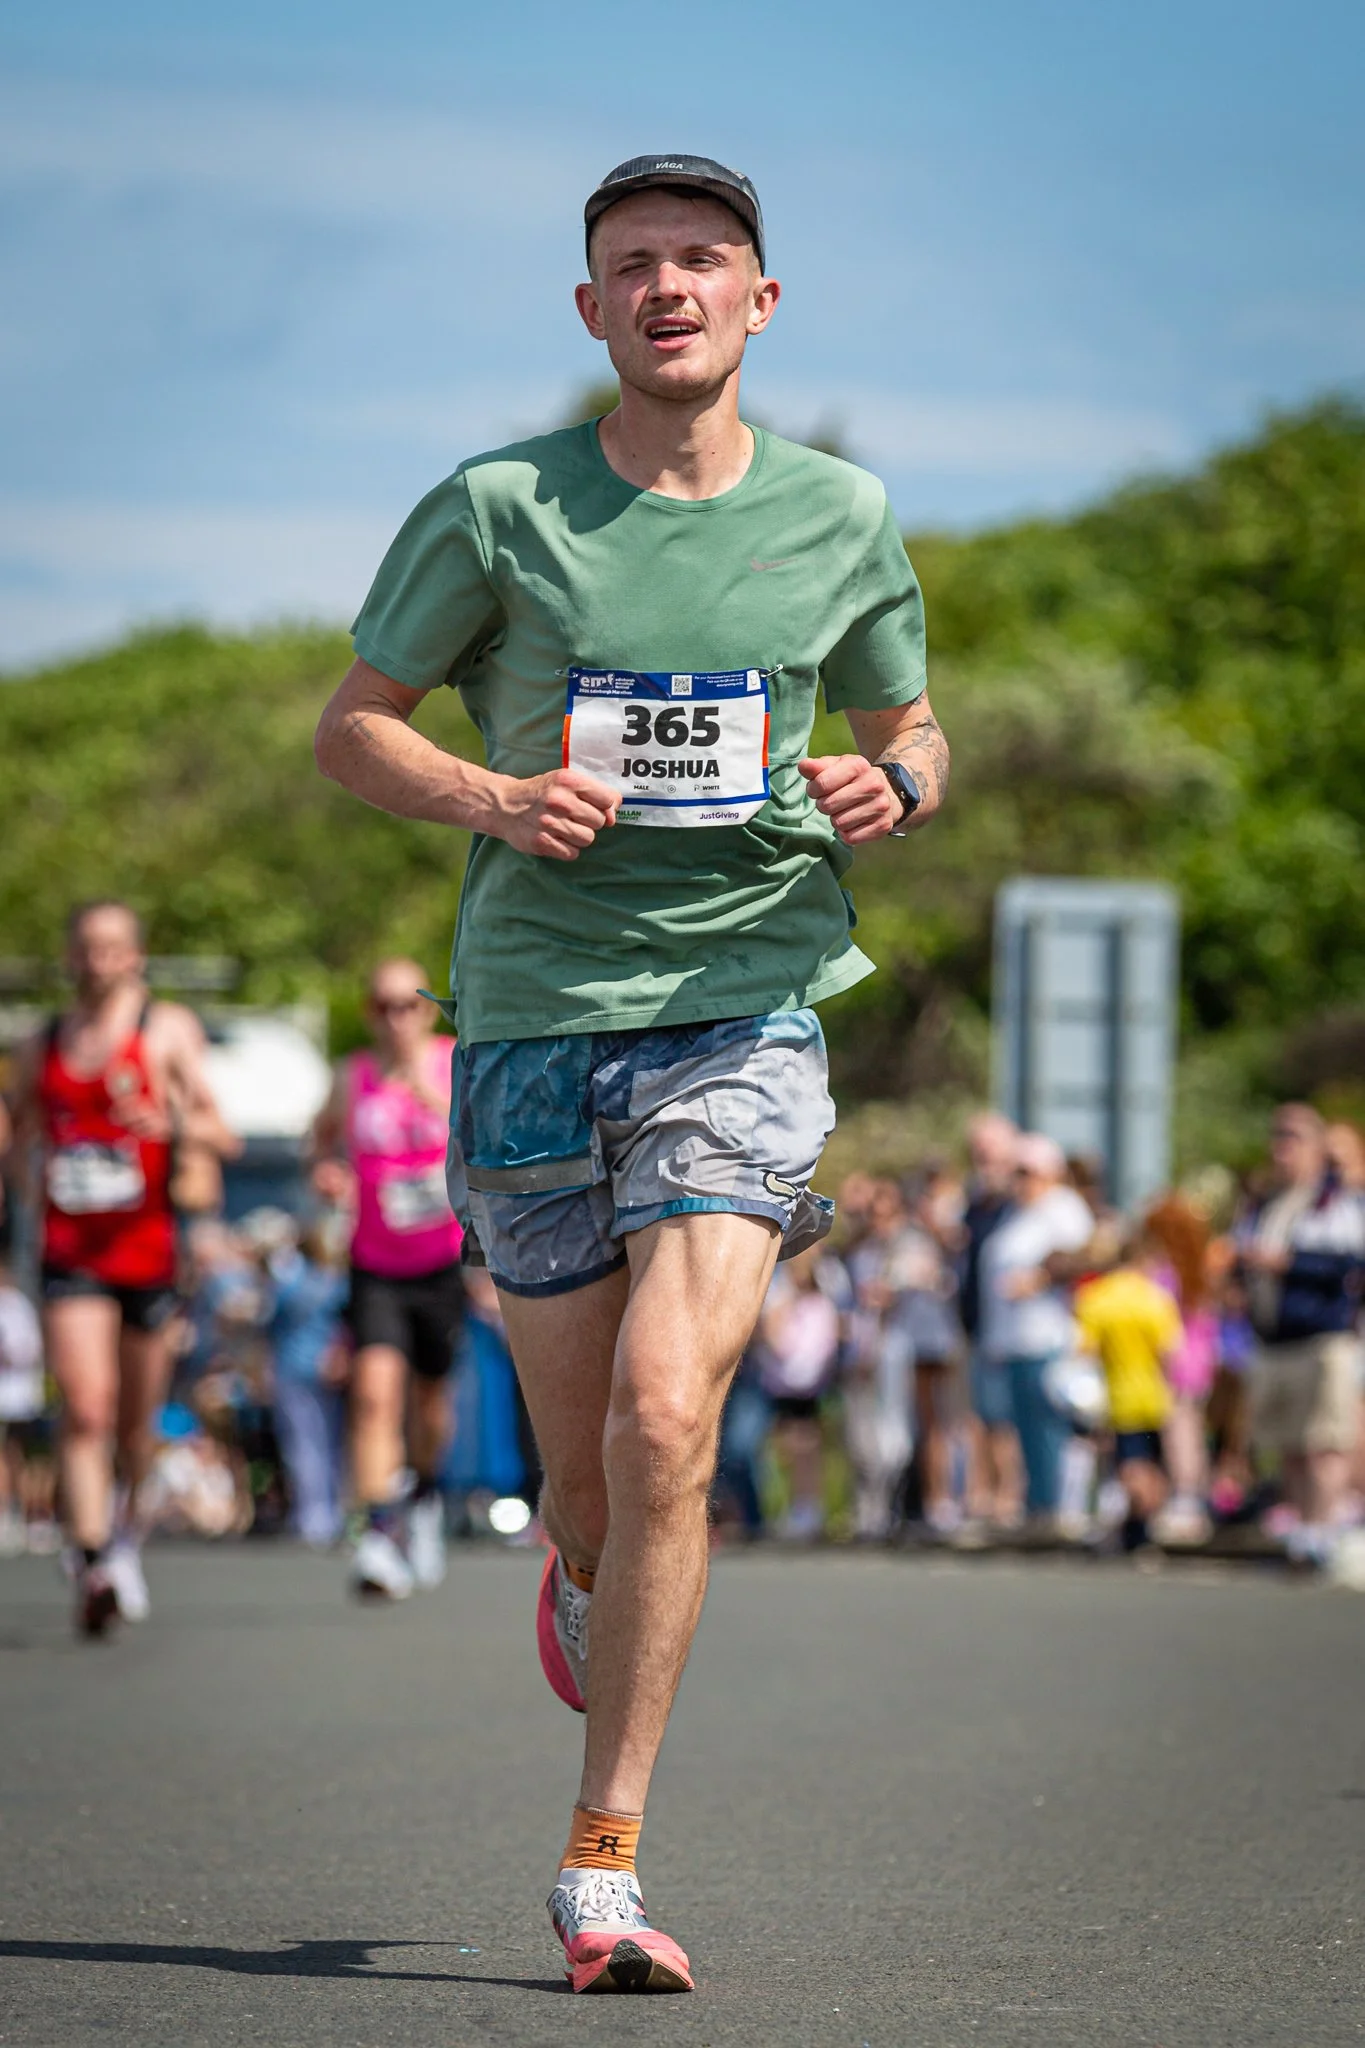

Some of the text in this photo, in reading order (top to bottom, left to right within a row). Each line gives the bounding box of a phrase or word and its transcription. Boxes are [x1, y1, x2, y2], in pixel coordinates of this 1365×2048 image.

[621, 704, 720, 747] 365
[621, 758, 720, 778] JOSHUA
[699, 811, 740, 820] JustGiving
